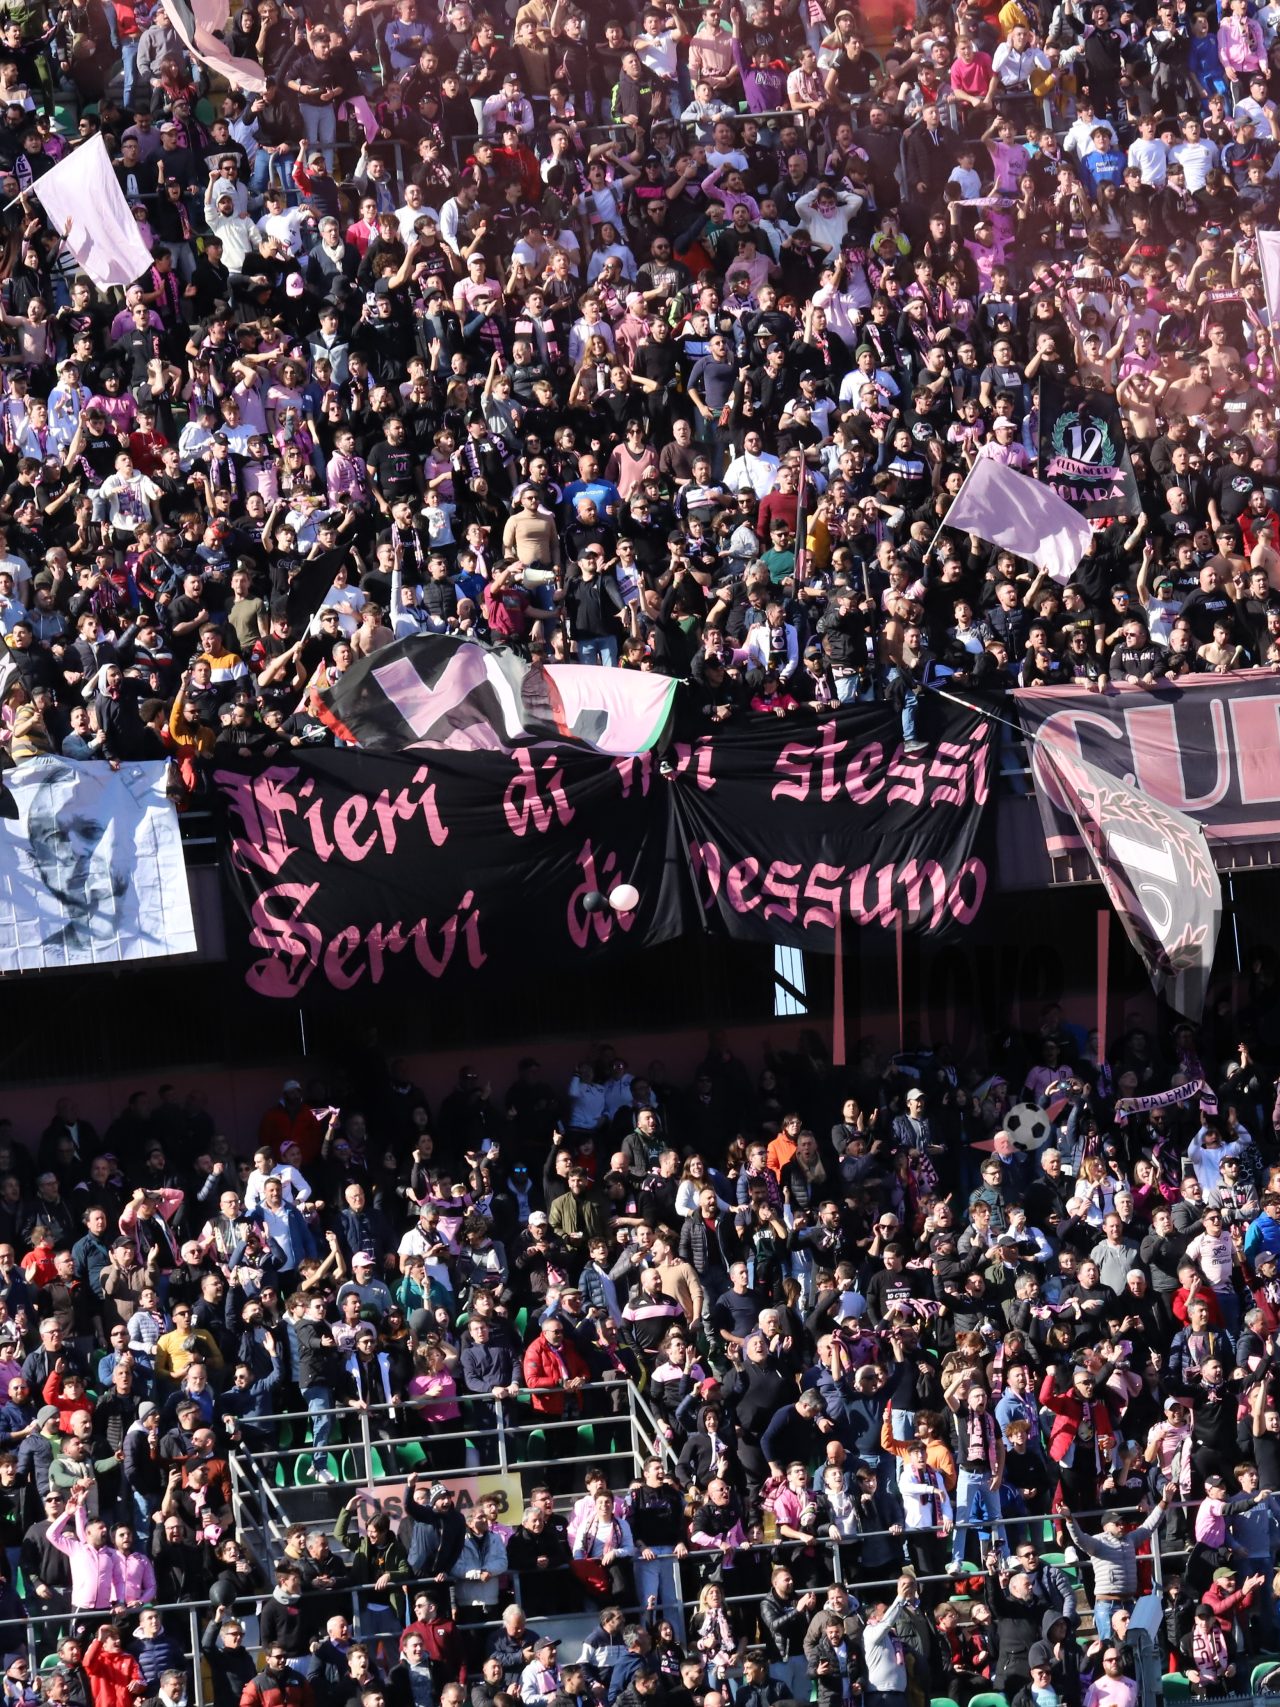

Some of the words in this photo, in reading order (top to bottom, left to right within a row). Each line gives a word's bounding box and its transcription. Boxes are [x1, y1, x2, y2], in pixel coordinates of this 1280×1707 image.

[1067, 425, 1102, 465] 12
[213, 764, 450, 876] Fieri
[503, 747, 576, 837] di
[771, 718, 991, 807] stessi
[246, 881, 488, 999] Servi
[567, 838, 636, 950] di
[1141, 1079, 1200, 1110] PALERMO
